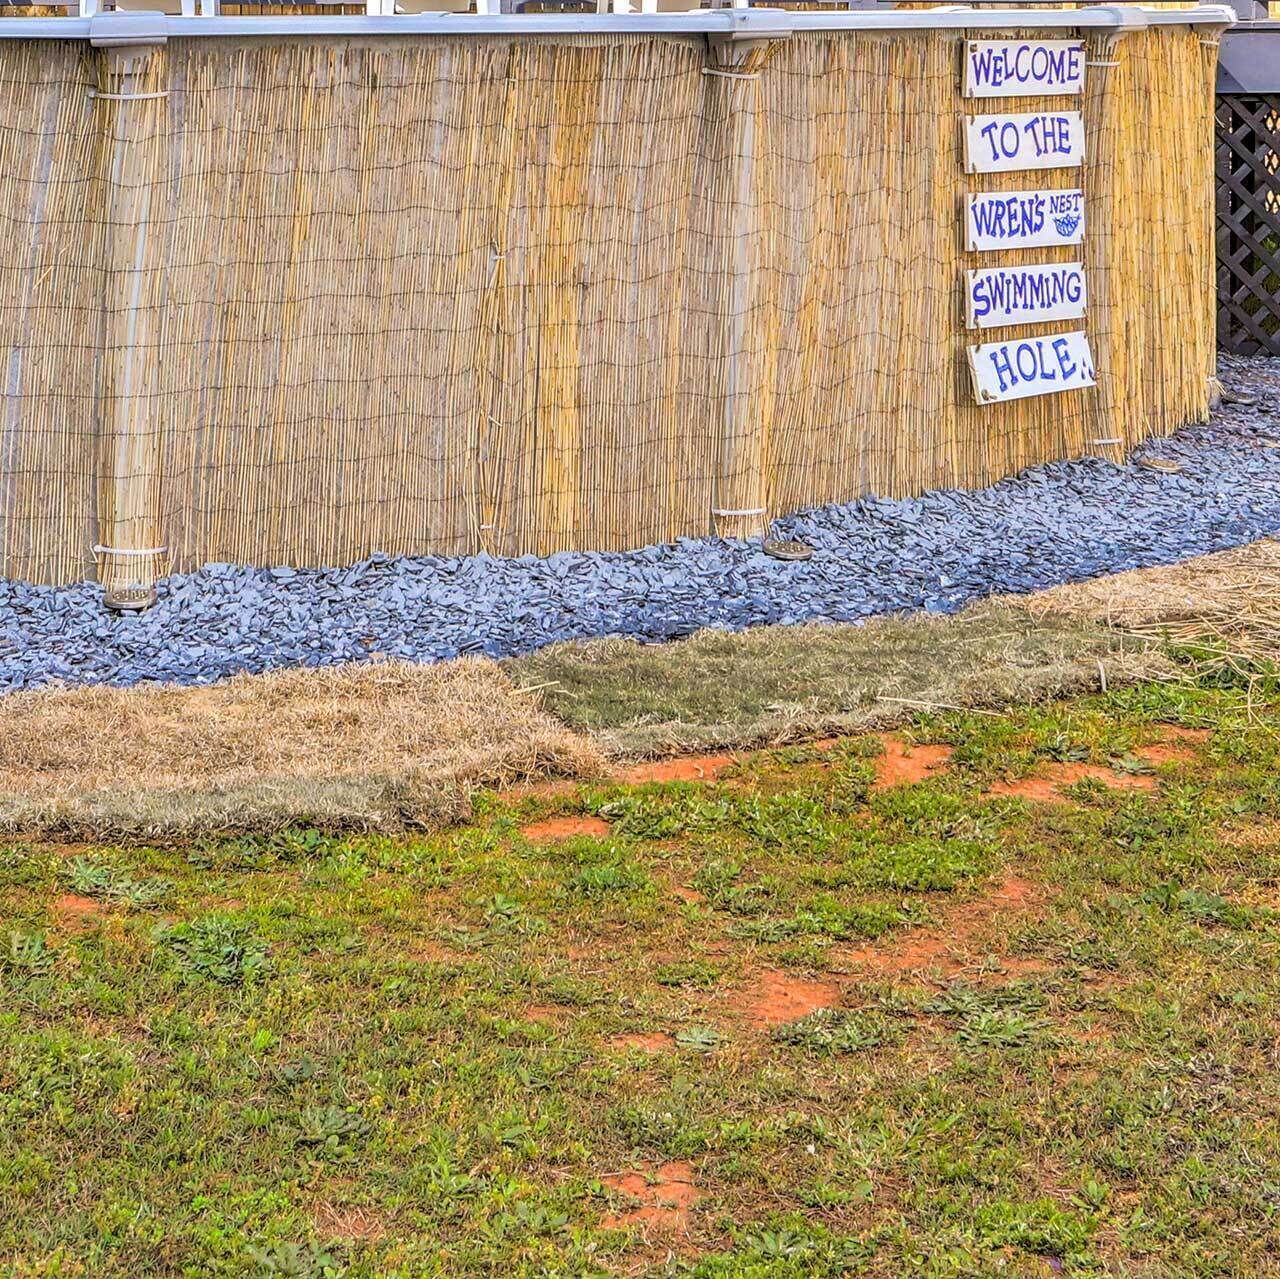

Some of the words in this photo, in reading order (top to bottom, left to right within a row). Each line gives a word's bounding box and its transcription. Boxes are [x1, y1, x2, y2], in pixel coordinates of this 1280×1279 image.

[972, 45, 1081, 86] WELCOME
[981, 121, 1020, 161] TO
[1024, 116, 1072, 157] THE
[971, 194, 1045, 237] WREN'S
[1049, 193, 1082, 214] NEST
[972, 270, 1081, 318] SWIMMING
[990, 338, 1077, 392] HOLE
